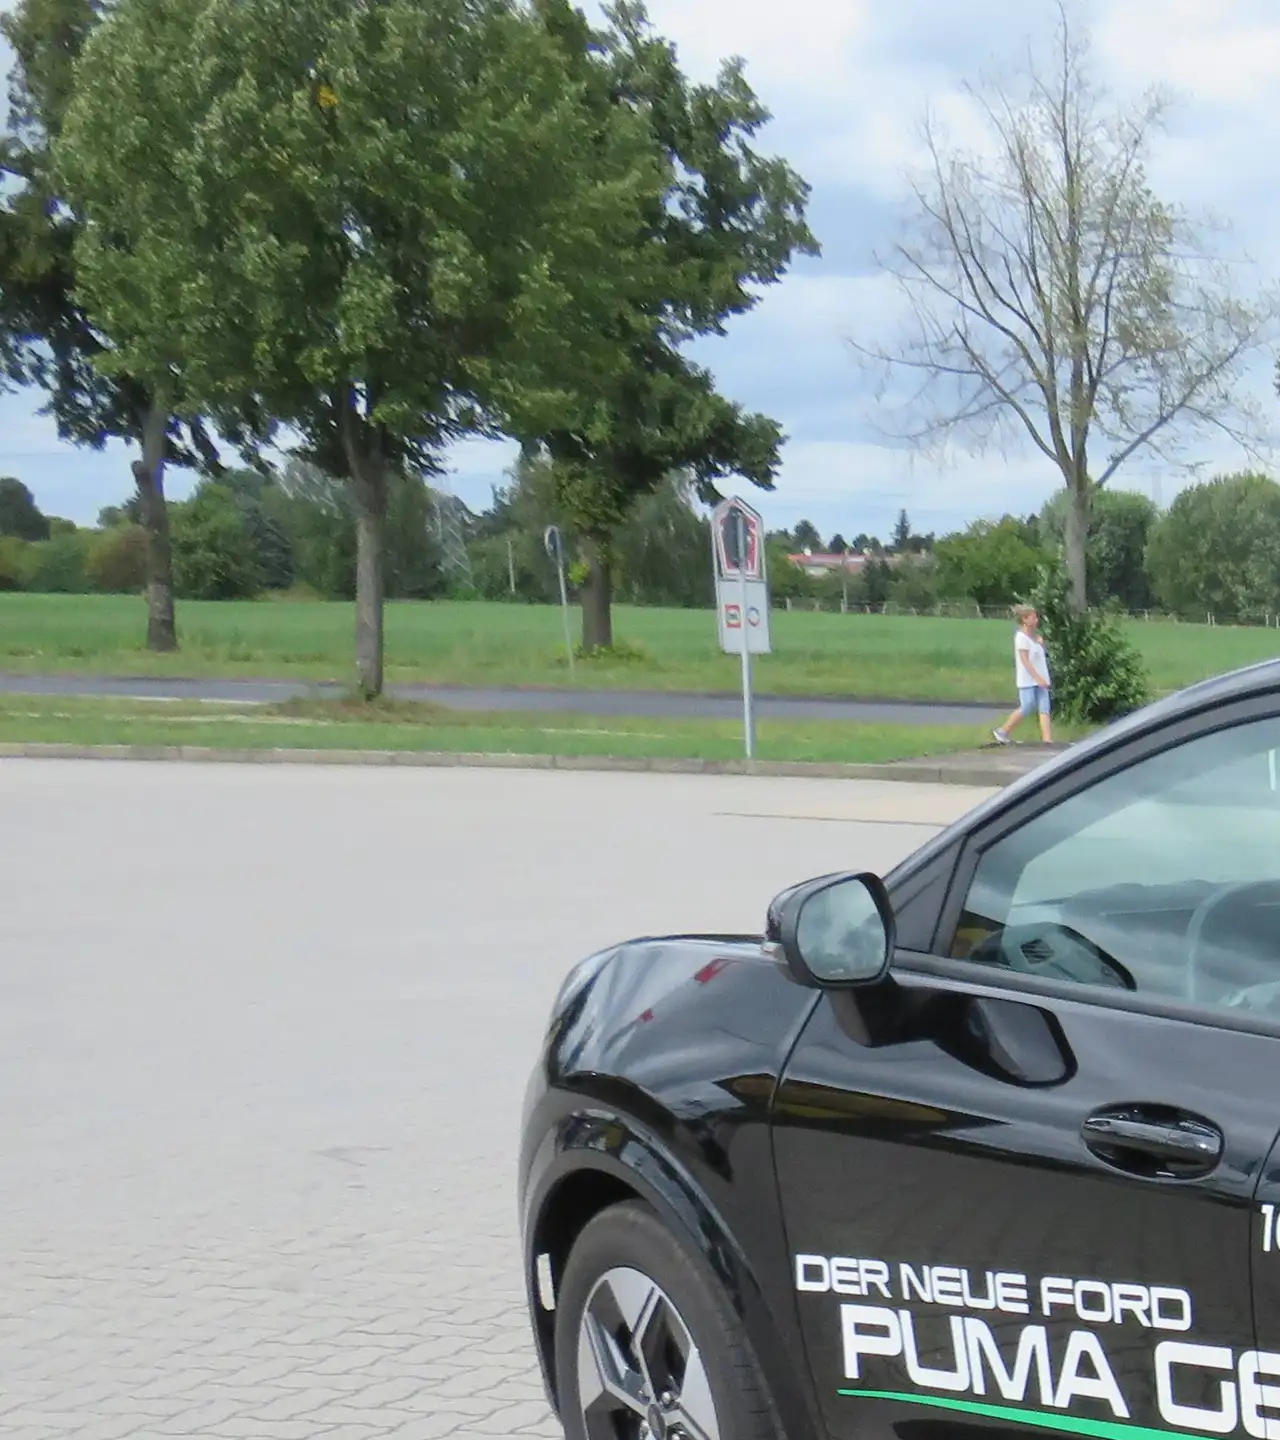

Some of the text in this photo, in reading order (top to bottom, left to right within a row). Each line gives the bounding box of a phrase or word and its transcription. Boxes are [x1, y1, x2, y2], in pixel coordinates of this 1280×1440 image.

[795, 1254, 1192, 1331] DER NEUE FORD
[839, 1303, 1131, 1418] PUMA
